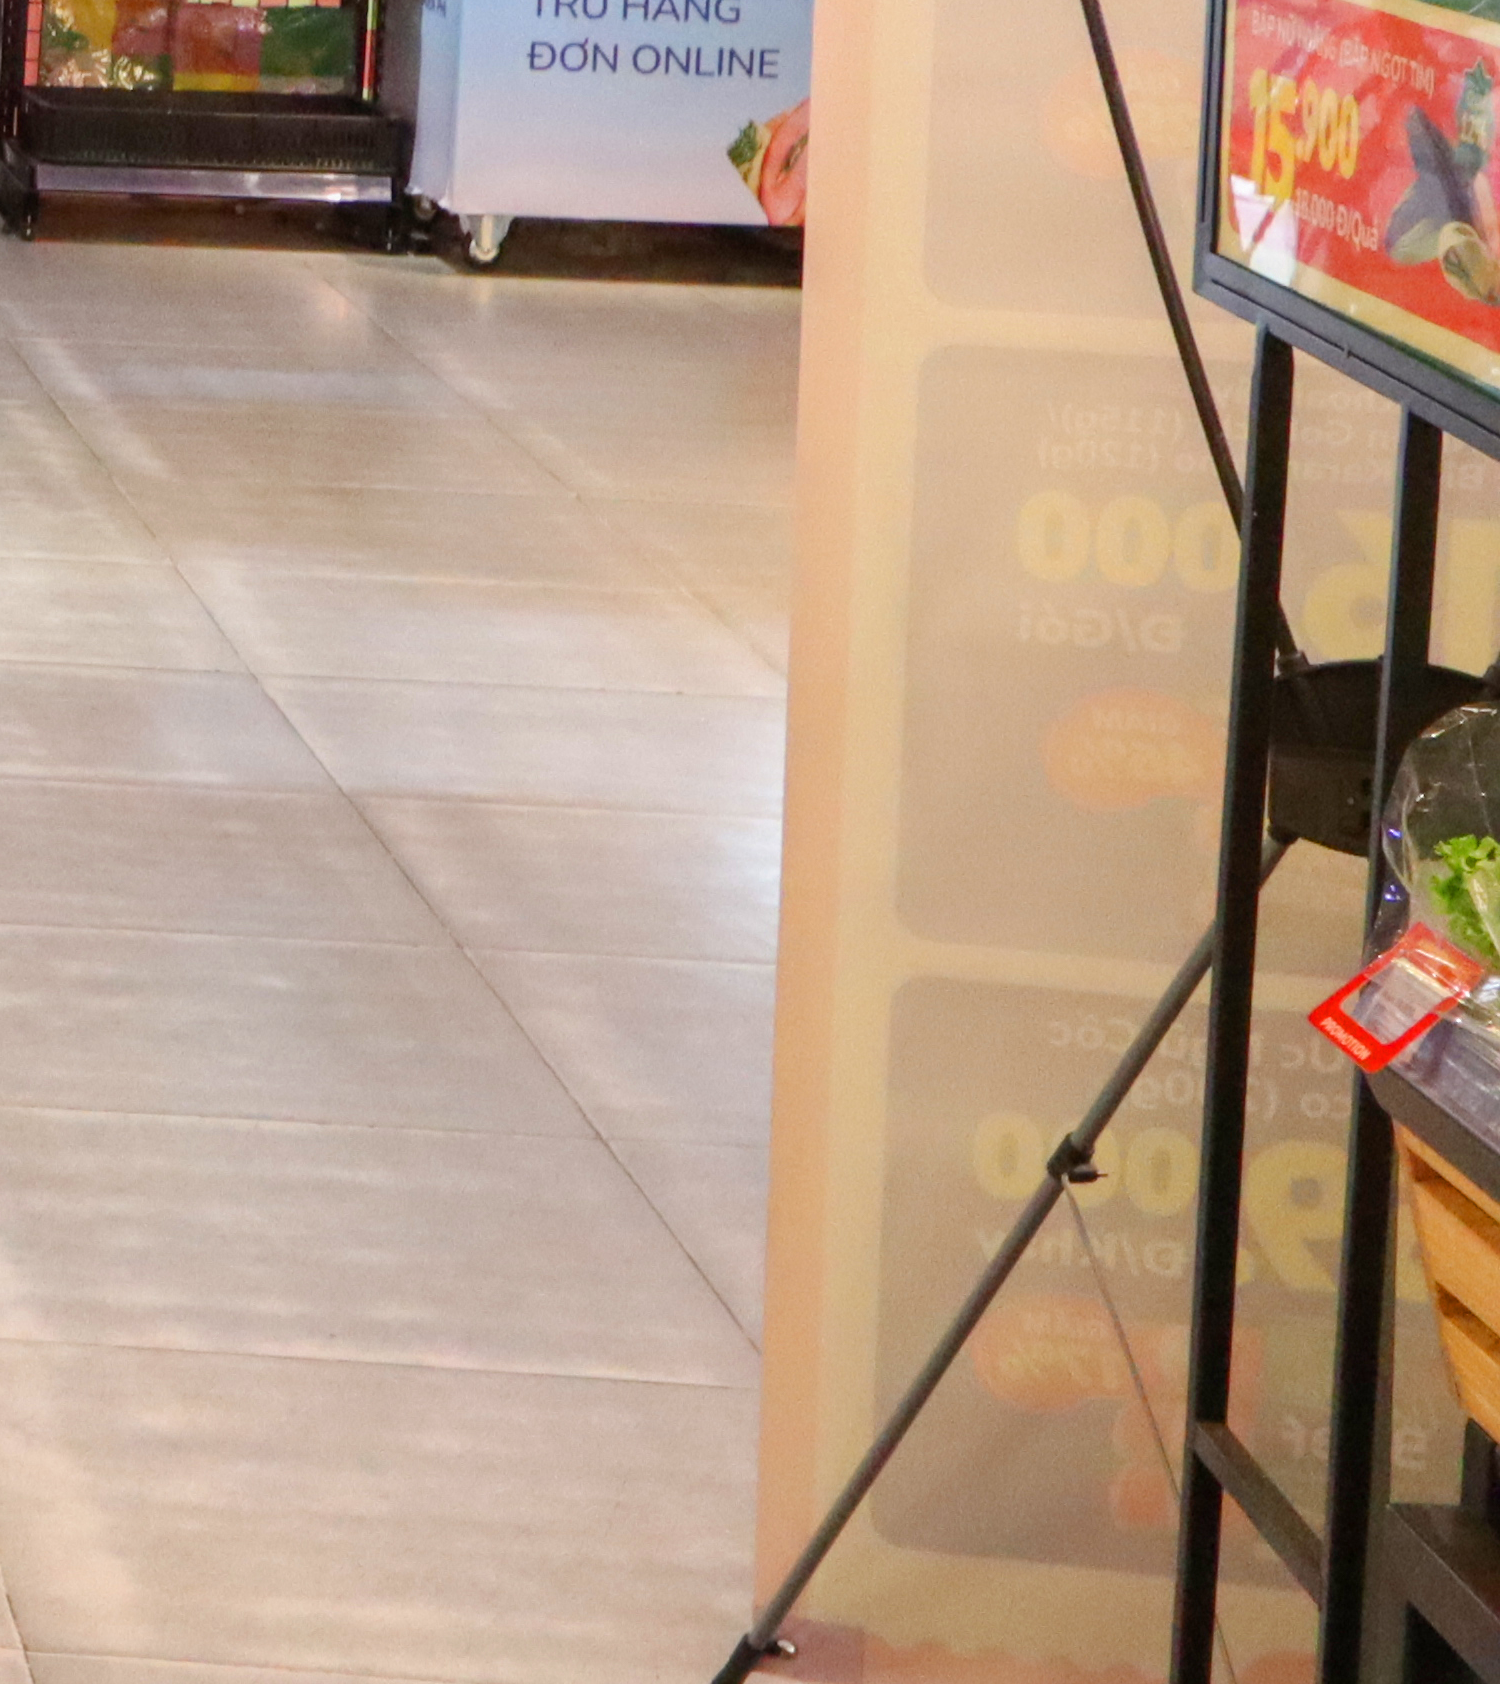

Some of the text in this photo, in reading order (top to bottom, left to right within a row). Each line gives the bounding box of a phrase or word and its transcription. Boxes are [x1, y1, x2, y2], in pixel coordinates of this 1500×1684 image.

[527, 37, 781, 80] ĐƠN ONLINE
[1319, 1016, 1372, 1061] PROMOTION
